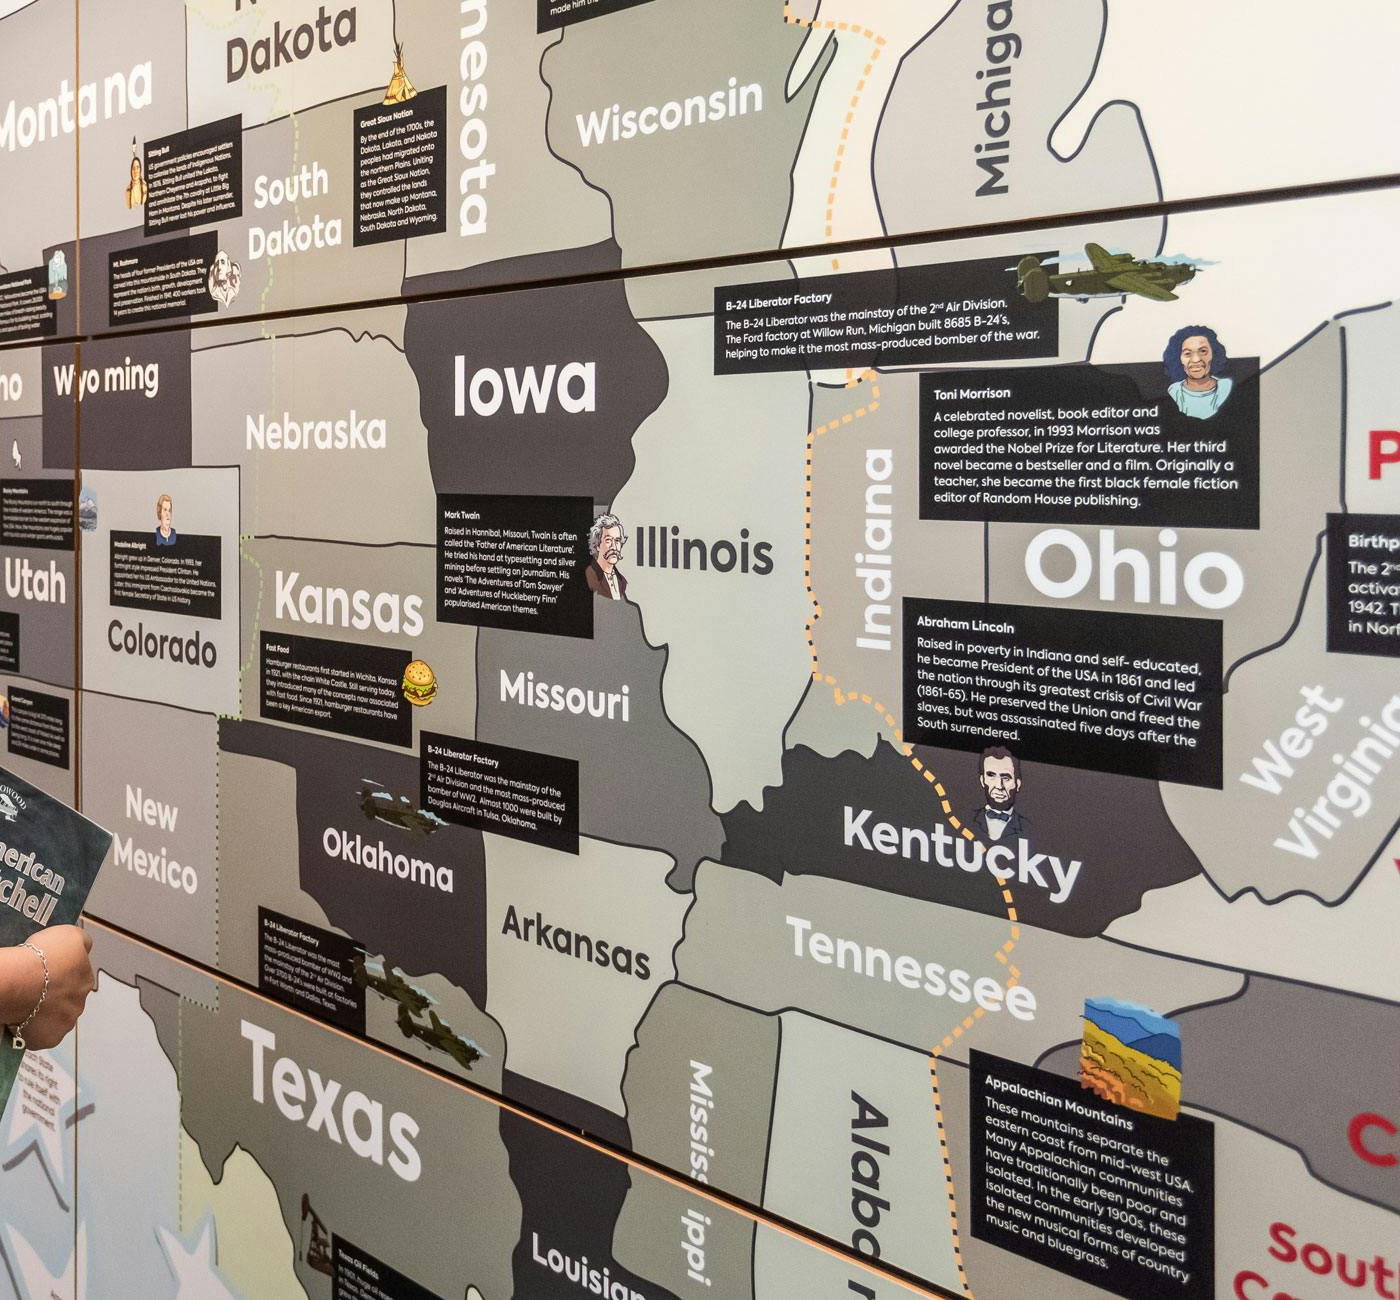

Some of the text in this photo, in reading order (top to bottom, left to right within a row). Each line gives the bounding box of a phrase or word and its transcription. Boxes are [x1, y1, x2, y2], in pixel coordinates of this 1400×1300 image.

[550, 5, 571, 15] made
[227, 6, 357, 84] Dakota
[360, 109, 413, 128] Great Sioux Nation
[575, 76, 763, 148] Wisconsin
[254, 161, 328, 209] South
[249, 214, 342, 260] Dakota
[359, 213, 437, 232] South Dakota and Wyoming.
[725, 293, 832, 310] B-24 Liberator Factory
[725, 298, 1007, 329] The B-24 Liberator was the mainstay of the 2nd Air Division.
[54, 357, 159, 400] Wyoming
[454, 354, 596, 417] Iowa
[933, 387, 1010, 400] Toni Morrison
[246, 410, 386, 450] Nebraska
[933, 405, 1158, 421] A celebrated novelist, book editor and
[444, 510, 480, 519] Mark Twain
[444, 526, 577, 540] Raised in Hannibal, Missouri, Twain is often
[636, 526, 774, 575] Illinois
[856, 448, 892, 651] Indiana
[1024, 528, 1244, 610] Ohio
[1348, 561, 1378, 575] The
[5, 557, 66, 604] Utah
[275, 570, 424, 637] Kansas
[916, 615, 1014, 633] Abraham Lincoln
[1348, 600, 1386, 615] 1942.
[1348, 620, 1362, 633] in
[108, 620, 216, 668] Colorado
[265, 643, 289, 653] Fast Food
[917, 637, 1201, 675] Raised in poverty in Indiana and self- educated,
[500, 670, 630, 722] Missouri
[427, 744, 498, 768] B-24 Liberator Factory
[1239, 684, 1344, 795] West
[126, 784, 178, 832] New
[427, 795, 451, 808] Douglas
[452, 802, 475, 814] Aircraft
[476, 807, 482, 816] in
[114, 832, 198, 894] Mexico
[322, 827, 453, 893] Oklahoma
[843, 805, 1082, 904] Kentucky
[501, 904, 651, 982] Arkansas
[786, 915, 1038, 1022] Tennessee
[240, 1019, 422, 1181] Texas
[984, 1074, 1133, 1130] Appalachian Mountains
[984, 1095, 1168, 1166] These mountains separate the
[985, 1115, 1193, 1192] eastern coast from mid-west USA.
